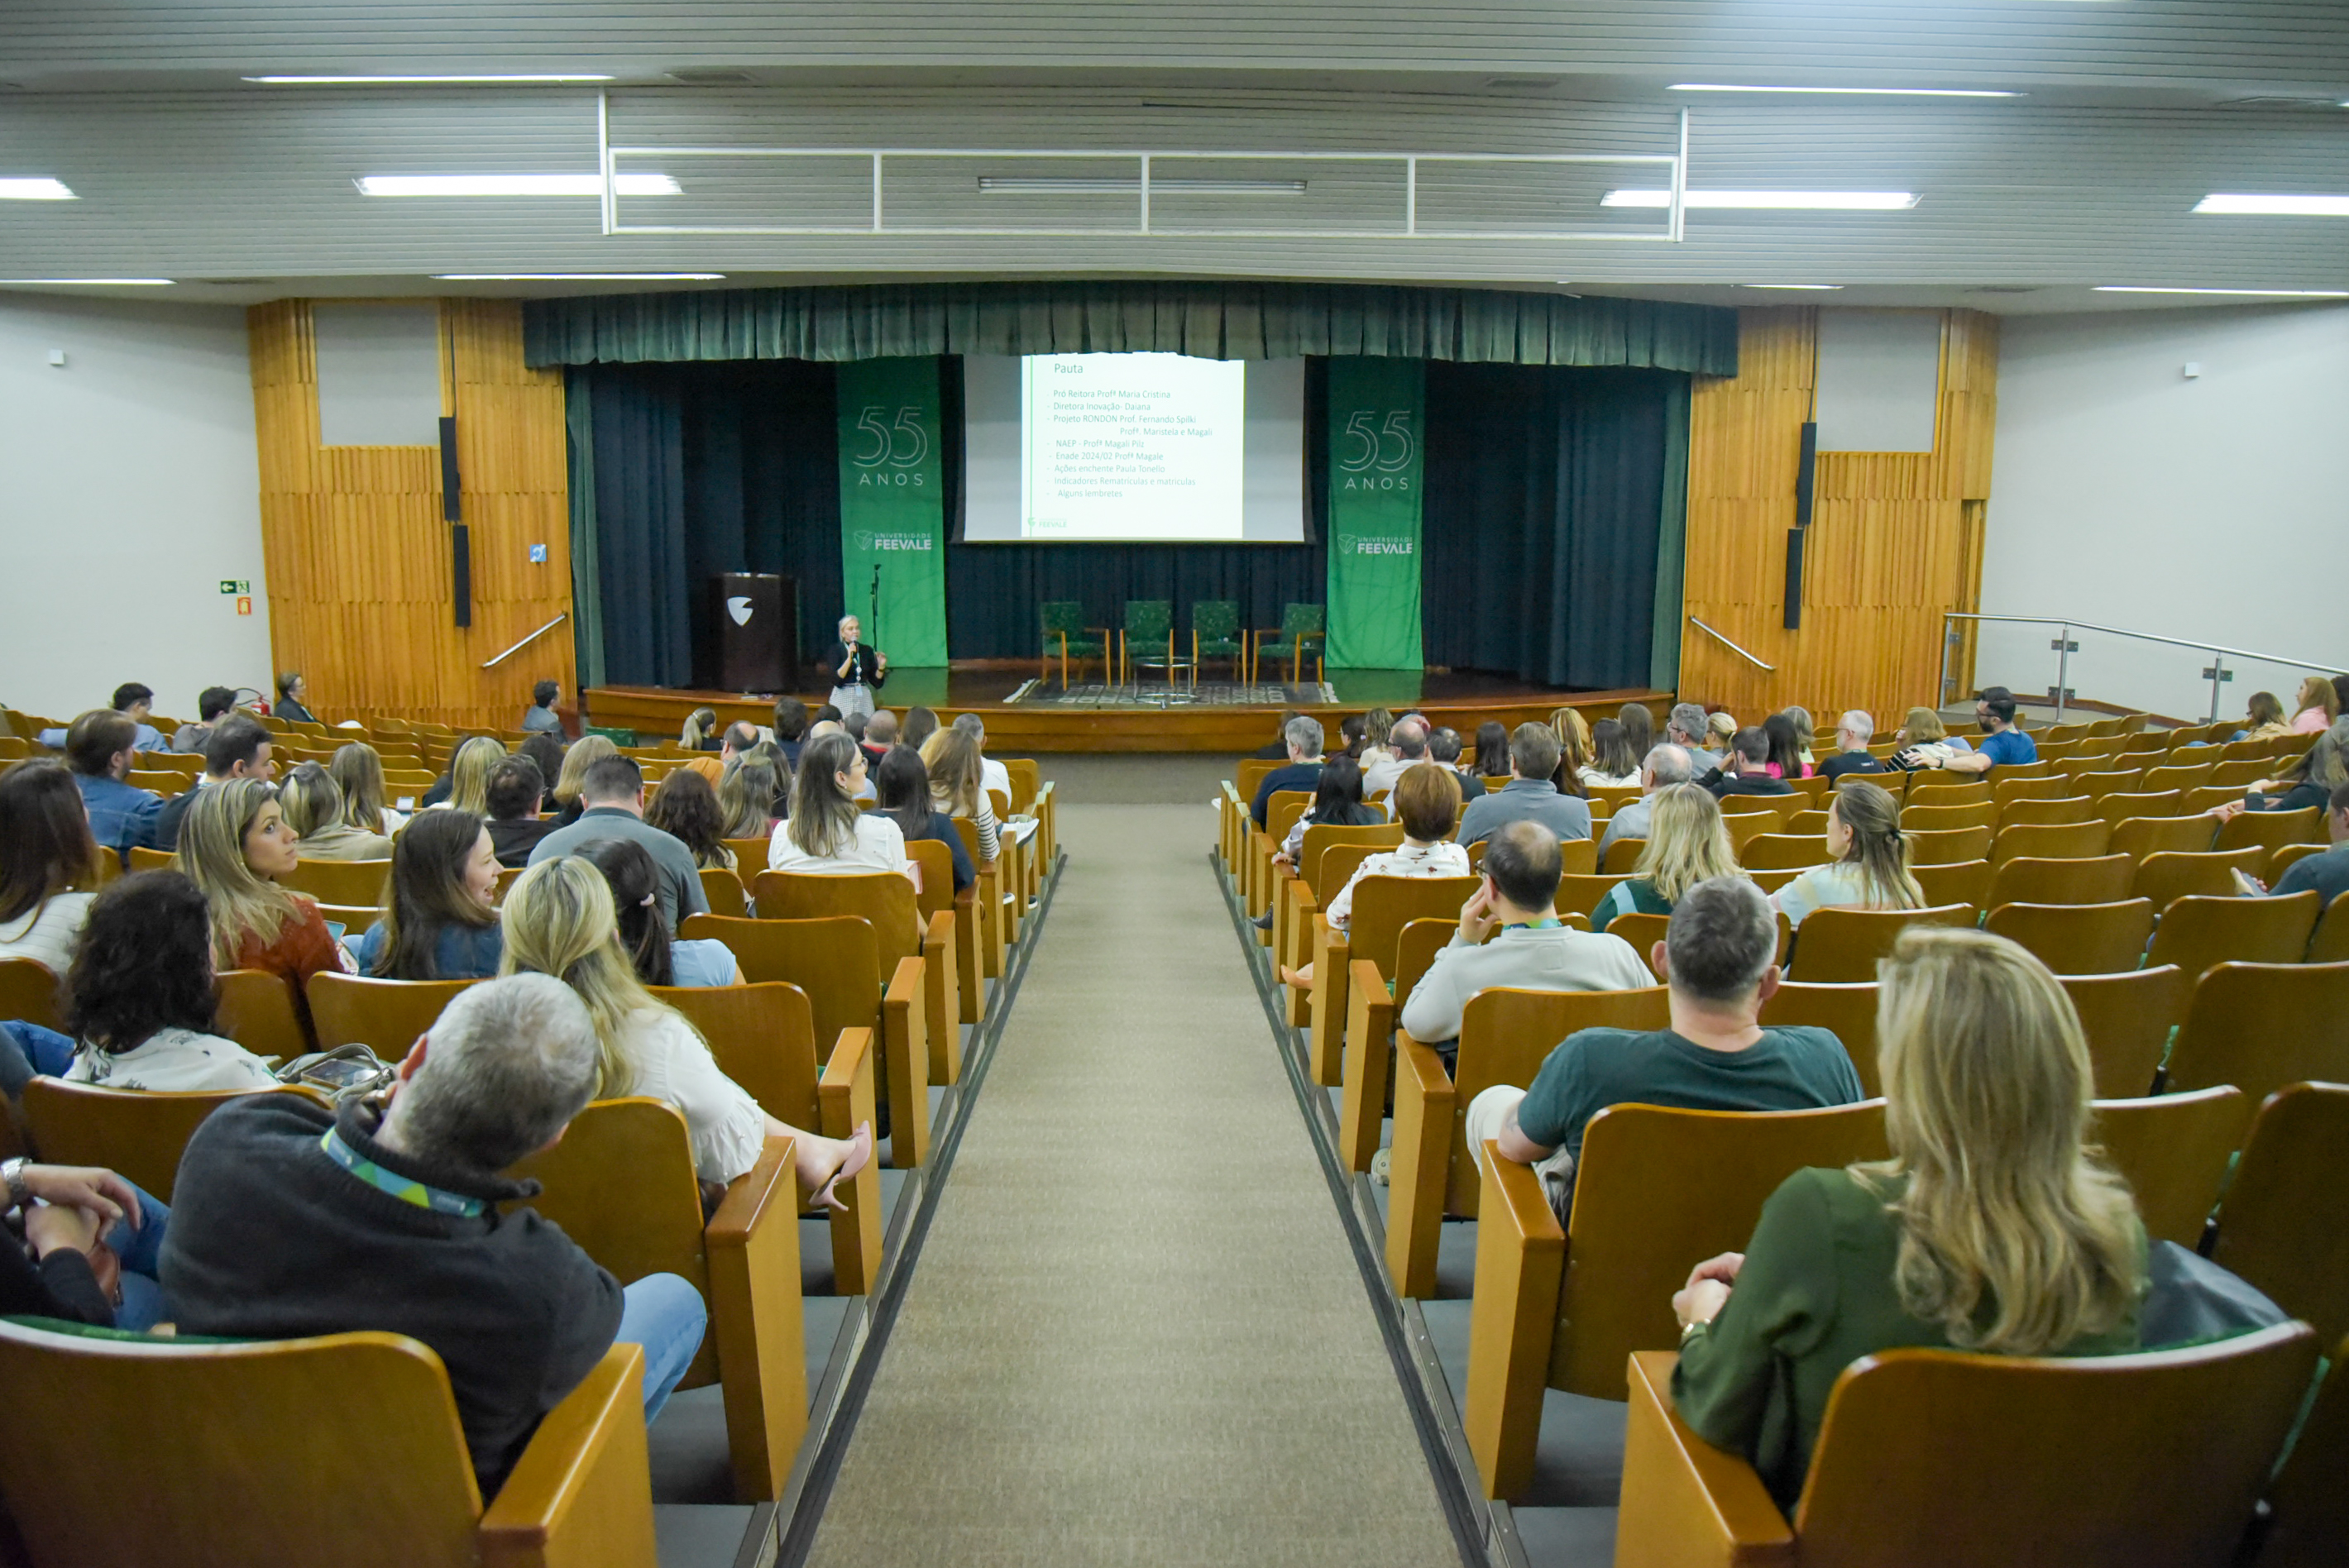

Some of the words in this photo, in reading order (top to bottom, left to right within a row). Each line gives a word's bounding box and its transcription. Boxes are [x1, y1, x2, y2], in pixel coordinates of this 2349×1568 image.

[1054, 364, 1084, 374] Pauta
[1054, 390, 1066, 398] Pró
[1142, 390, 1170, 399] Cristina
[1125, 403, 1151, 411] Daiana
[1054, 415, 1081, 424] Projeto
[1139, 415, 1174, 423] Fernando
[1177, 415, 1196, 424] Spilki
[853, 406, 927, 467] 55
[1144, 428, 1179, 436] Maristela
[1187, 428, 1213, 437] Magali
[1105, 440, 1130, 449] Magali
[1339, 411, 1414, 471] 55
[1082, 452, 1112, 461] 2024/02
[1136, 452, 1164, 461] Magale
[1055, 465, 1077, 474] Ações
[859, 473, 923, 486] ANOS
[1345, 477, 1409, 490] ANOS
[1058, 490, 1083, 499] Alguns
[874, 539, 931, 550] FEEVALE
[1358, 543, 1413, 554] FEEVALE
